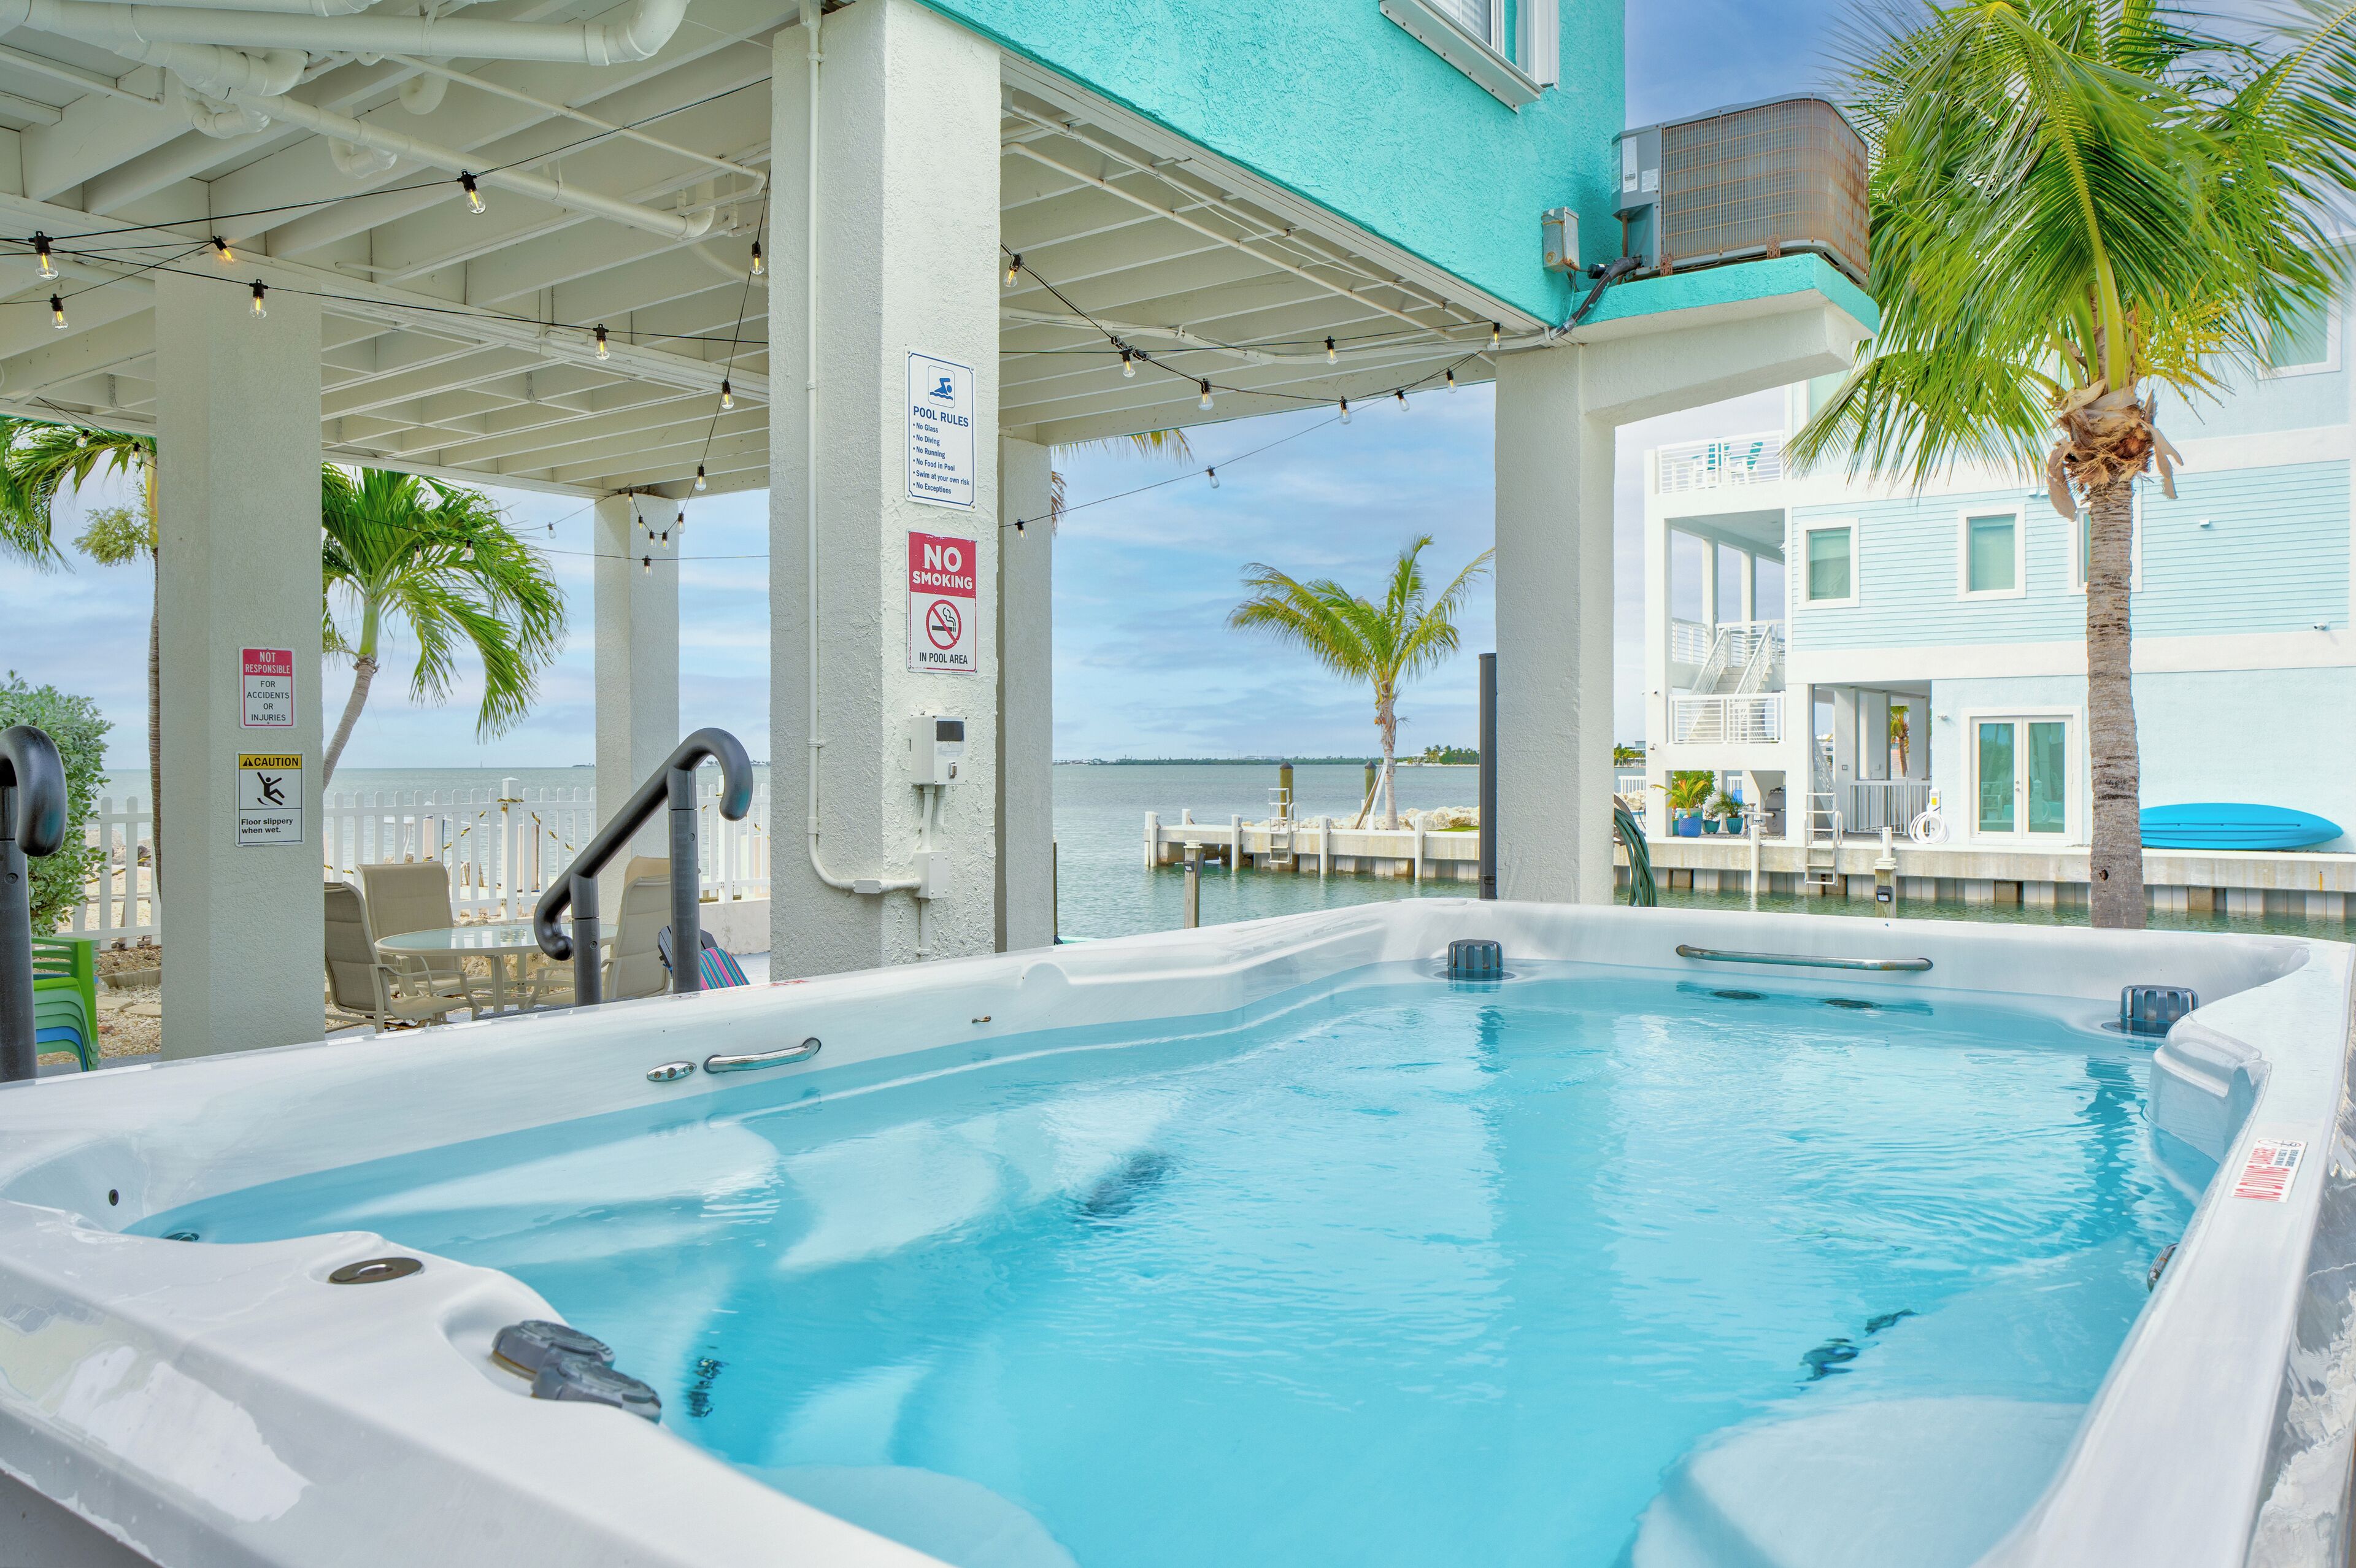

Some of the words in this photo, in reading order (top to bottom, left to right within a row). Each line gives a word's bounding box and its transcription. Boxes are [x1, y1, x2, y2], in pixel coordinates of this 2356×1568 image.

[914, 405, 937, 421] POOL
[941, 412, 969, 427] RULES
[916, 422, 923, 431] No
[925, 424, 938, 433] Glass
[925, 436, 940, 447] Diving
[925, 448, 945, 459] Running
[925, 459, 936, 468] Food
[944, 463, 955, 471] Pool
[916, 470, 930, 479] Swim
[937, 475, 949, 484] your
[961, 477, 970, 486] risk
[925, 483, 951, 494] Exceptions
[923, 543, 962, 572] NO
[912, 571, 972, 590] SMOKING
[260, 651, 276, 663] NOT
[919, 652, 927, 662] IN
[929, 653, 947, 663] POOL
[949, 654, 968, 664] AREA
[245, 664, 290, 674] RESPONSIBLE
[254, 757, 299, 766] CAUTION
[2239, 1165, 2290, 1189] DIVING
[2234, 1188, 2282, 1202] NO
